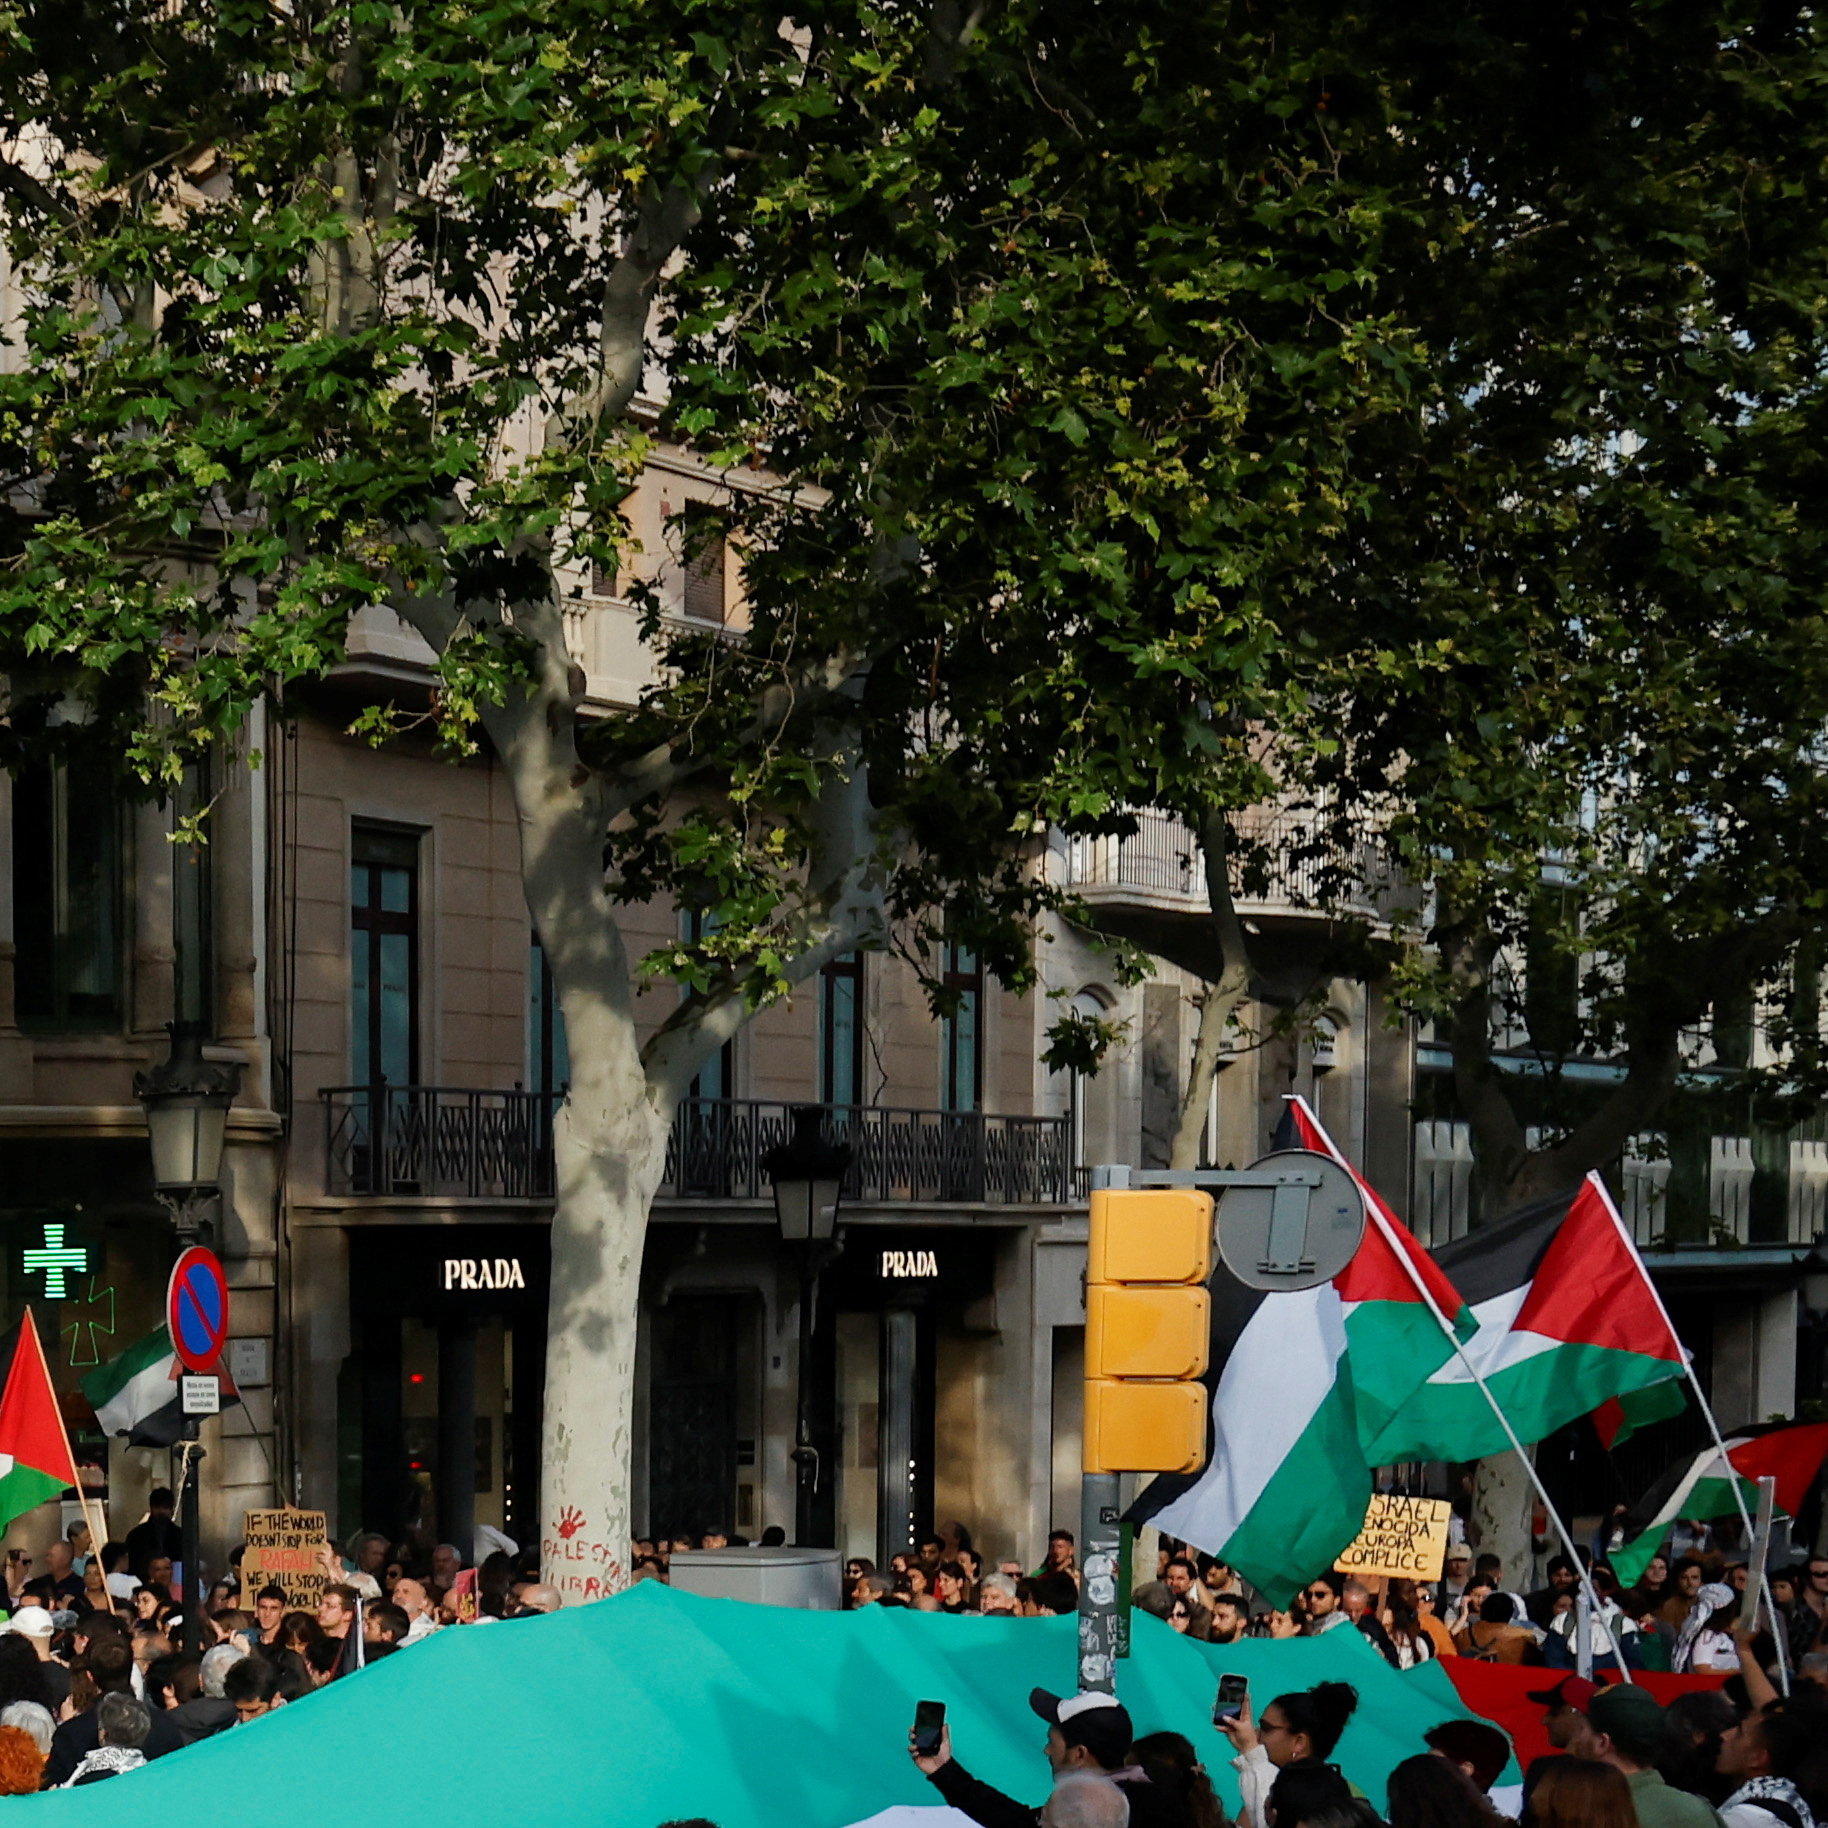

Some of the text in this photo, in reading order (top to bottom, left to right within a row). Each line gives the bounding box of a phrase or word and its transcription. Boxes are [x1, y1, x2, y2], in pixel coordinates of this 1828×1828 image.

[445, 1258, 525, 1290] PRADA
[882, 1250, 938, 1278] PRADA
[1371, 1496, 1445, 1523] SRAEL
[246, 1513, 324, 1531] IF THE WORLD
[282, 1534, 302, 1549] STOP
[259, 1548, 313, 1572] RAFAH
[1339, 1546, 1429, 1571] COMPLICE
[246, 1571, 324, 1589] WE WILL STOP
